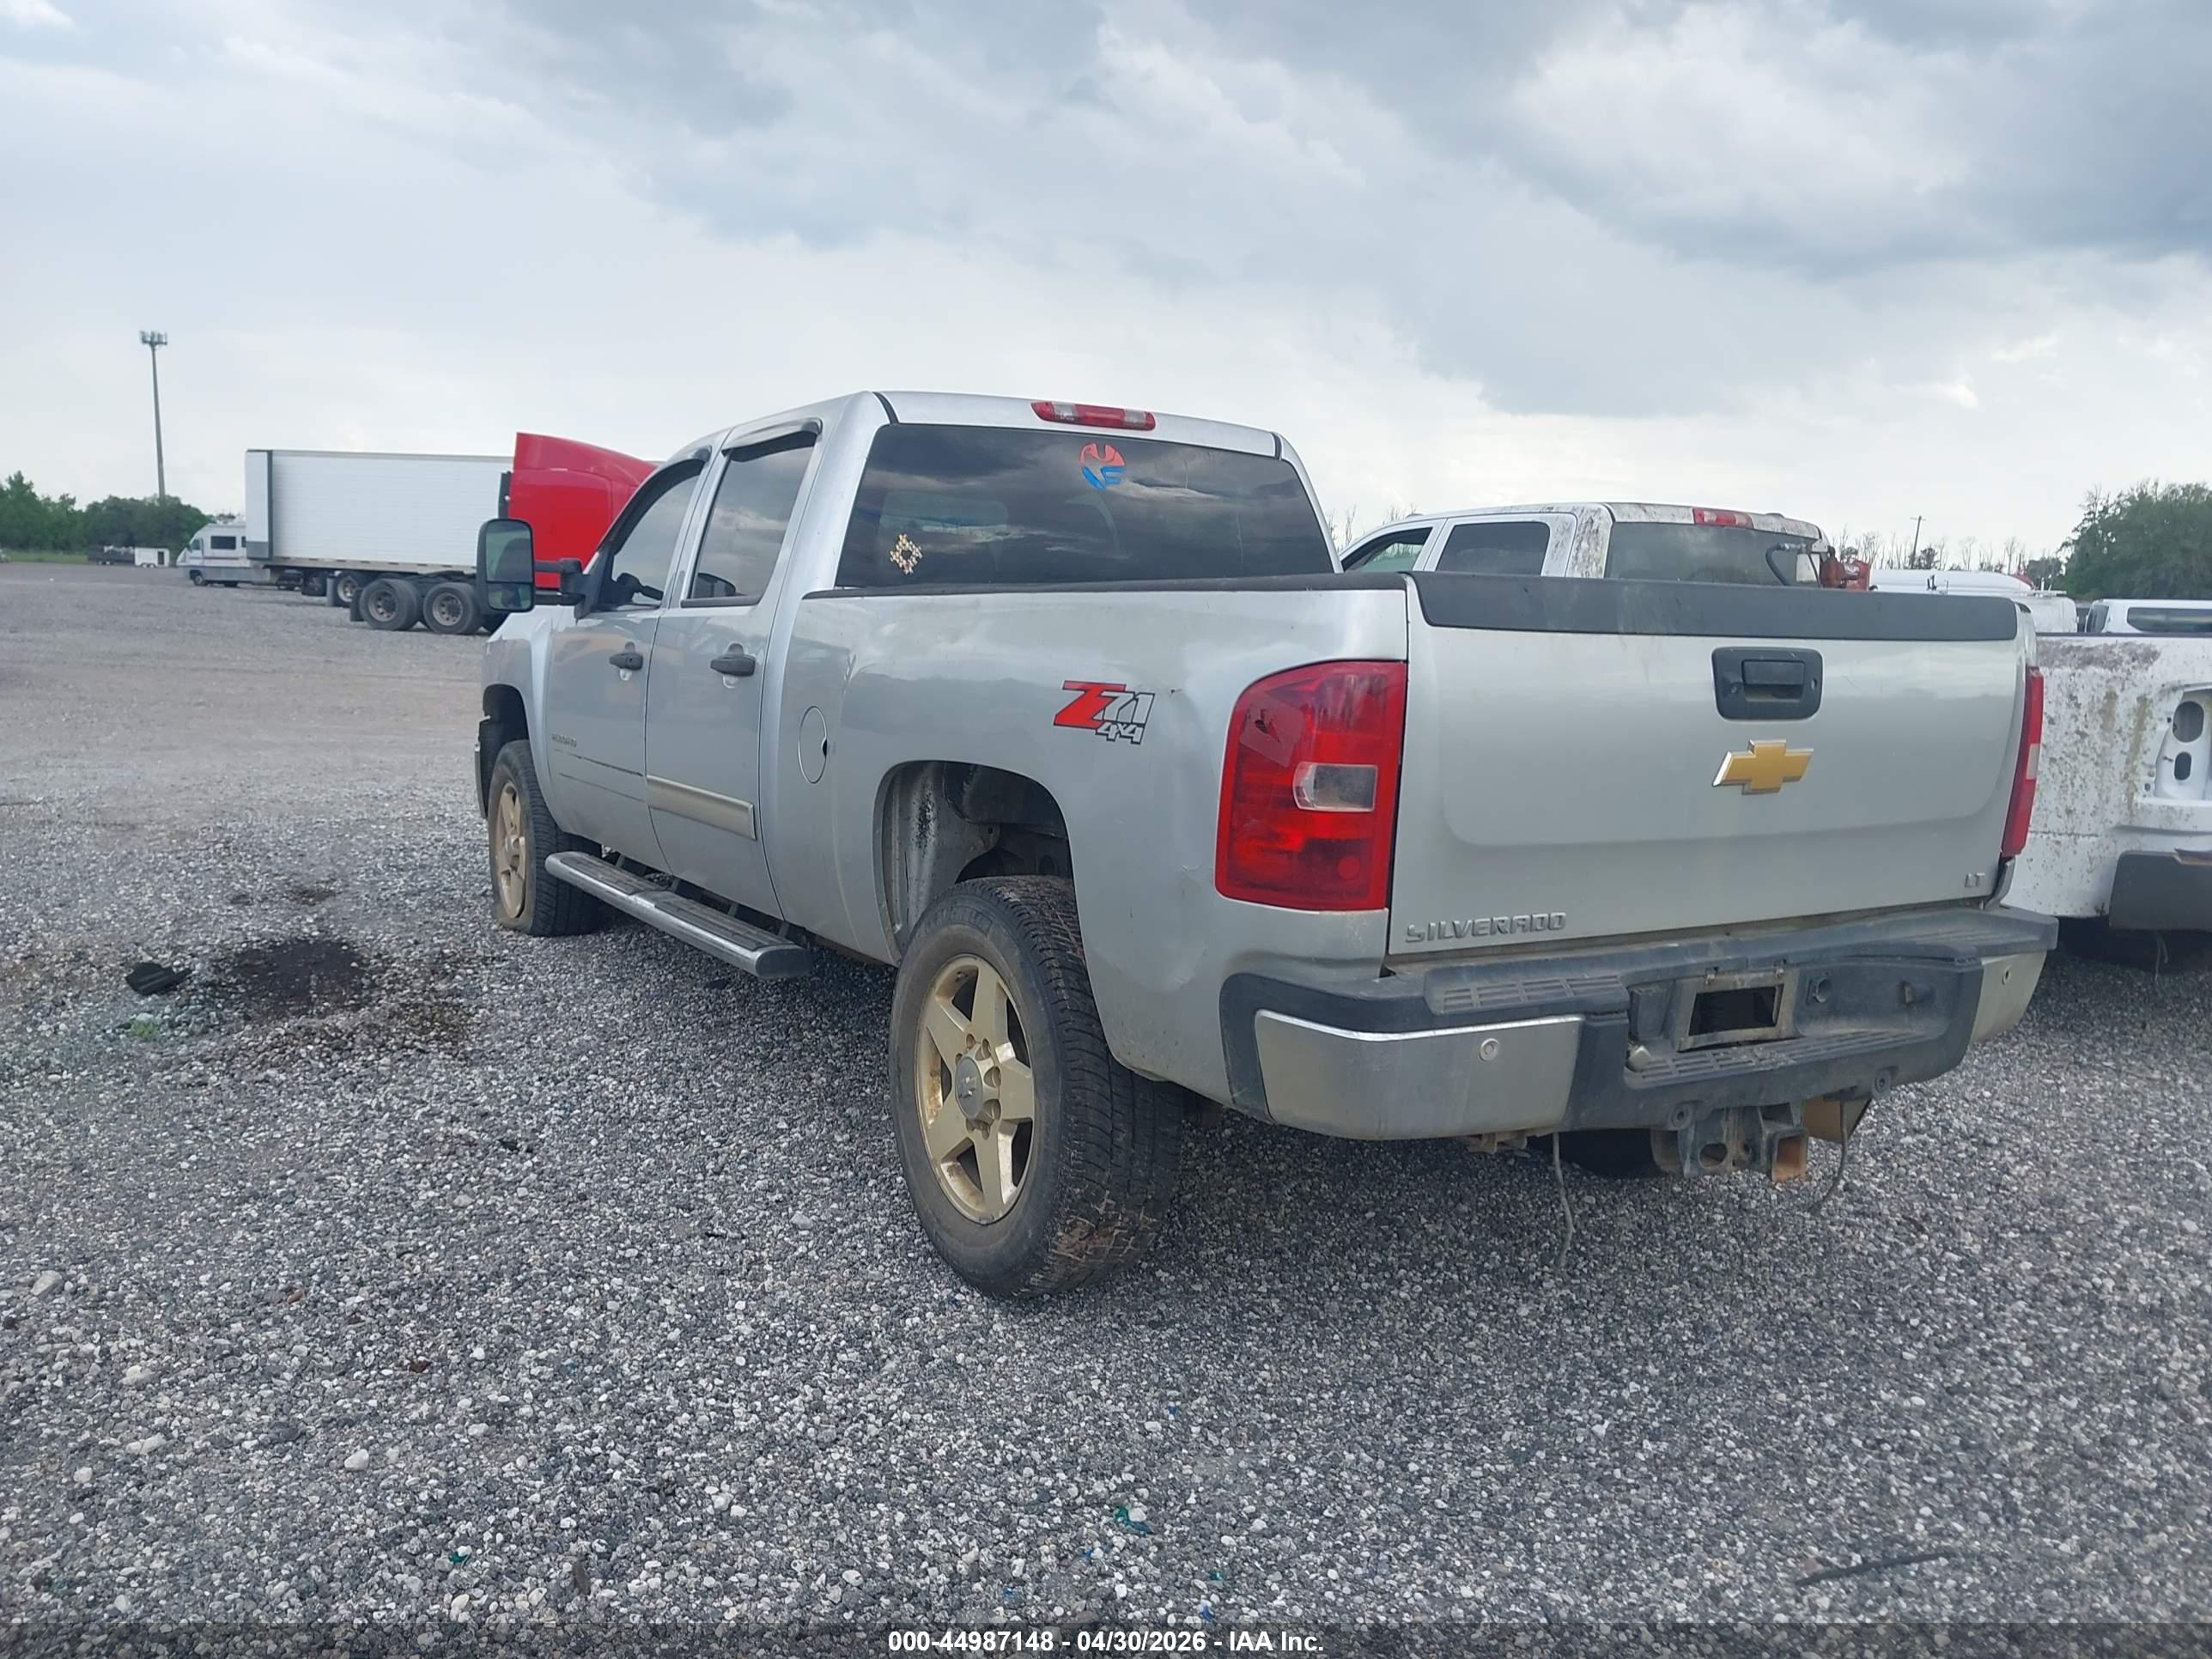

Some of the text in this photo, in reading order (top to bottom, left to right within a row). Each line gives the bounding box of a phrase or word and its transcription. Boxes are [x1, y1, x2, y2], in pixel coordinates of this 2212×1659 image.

[1053, 680, 1155, 729] Z71
[1964, 872, 1986, 888] LT
[1405, 912, 1567, 943] SILVERADO
